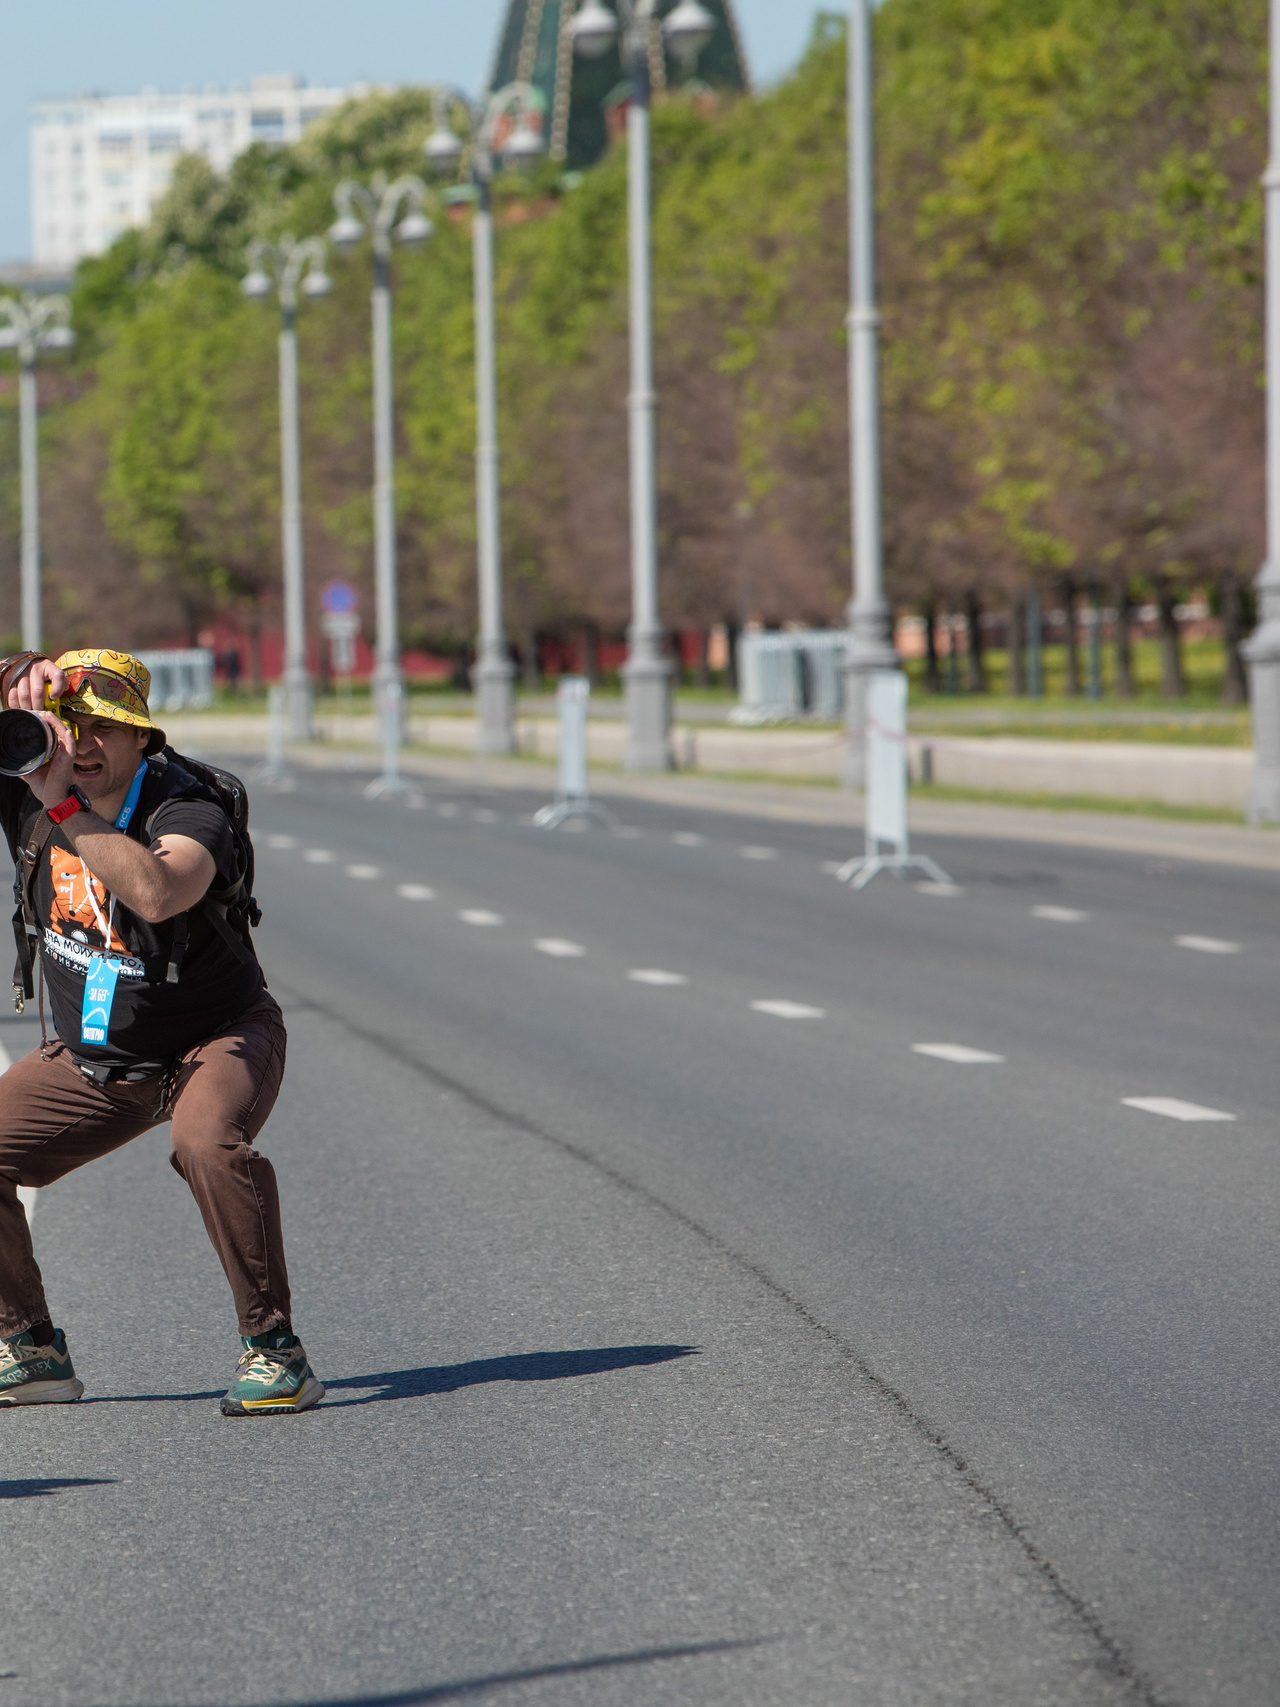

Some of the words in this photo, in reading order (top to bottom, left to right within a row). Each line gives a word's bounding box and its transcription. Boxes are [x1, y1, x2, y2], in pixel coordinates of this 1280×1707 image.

[119, 807, 131, 828] ПСБ
[46, 930, 61, 946] НА
[63, 939, 94, 958] МОИХ
